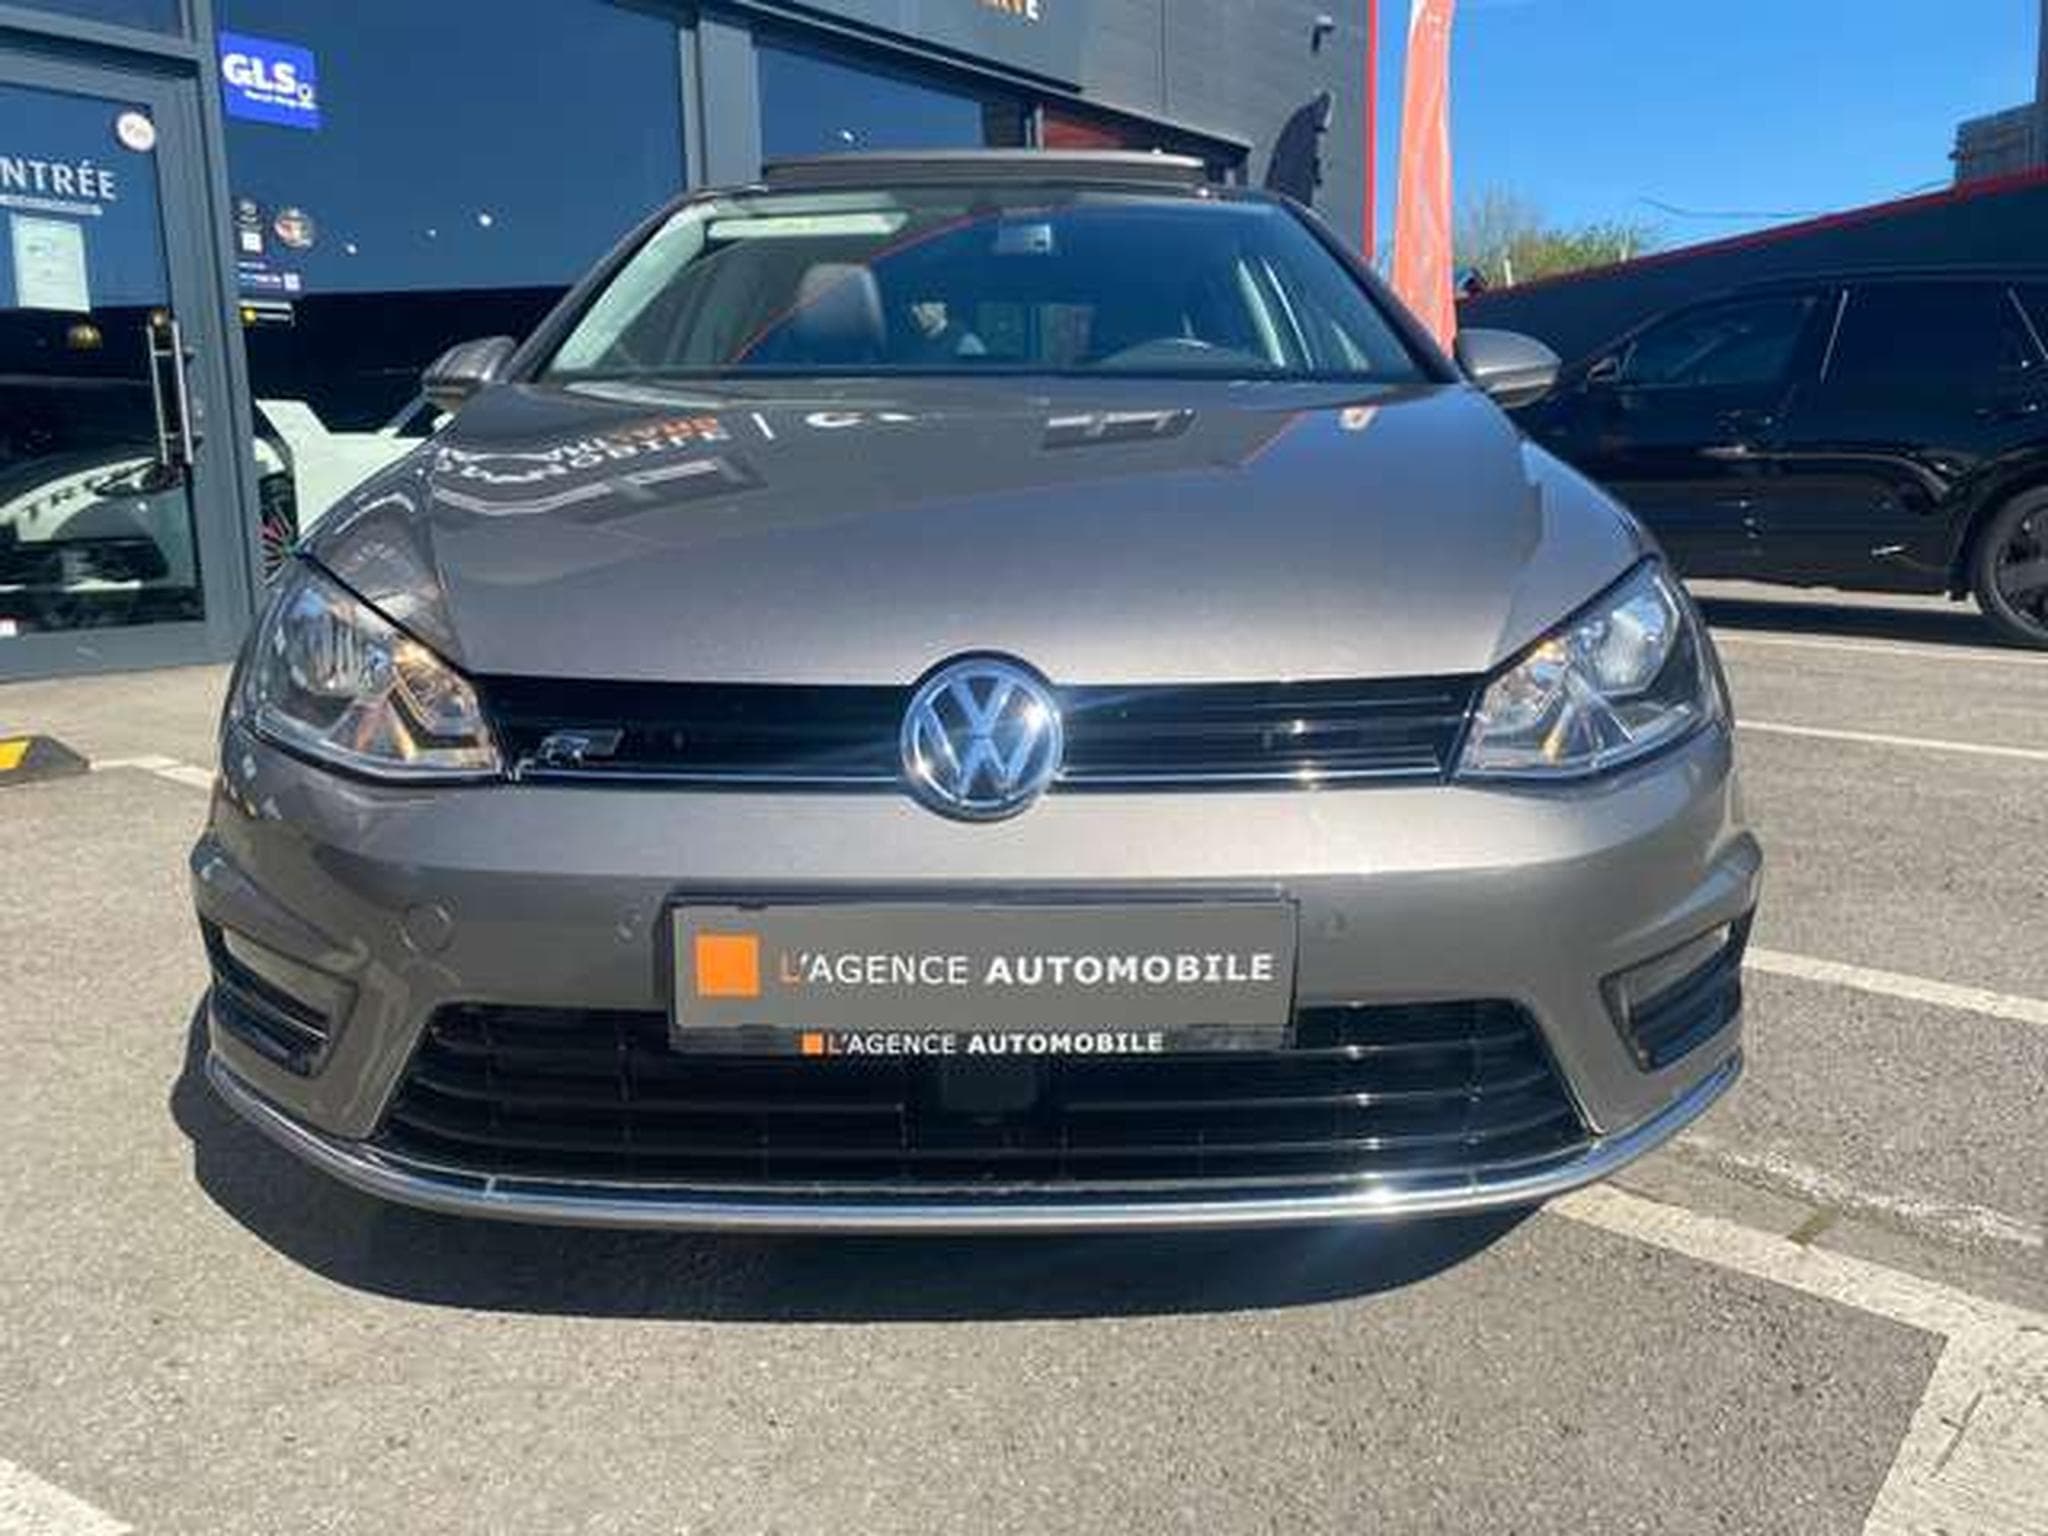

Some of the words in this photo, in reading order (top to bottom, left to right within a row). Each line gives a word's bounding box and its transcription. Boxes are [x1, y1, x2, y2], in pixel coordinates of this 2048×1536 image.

[223, 53, 296, 94] GLS
[780, 952, 970, 985] L'AGENCE
[984, 952, 1274, 985] AUTOMOBILE
[827, 1032, 956, 1056] L'AGENCE
[967, 1031, 1163, 1055] AUTOMOBILE
